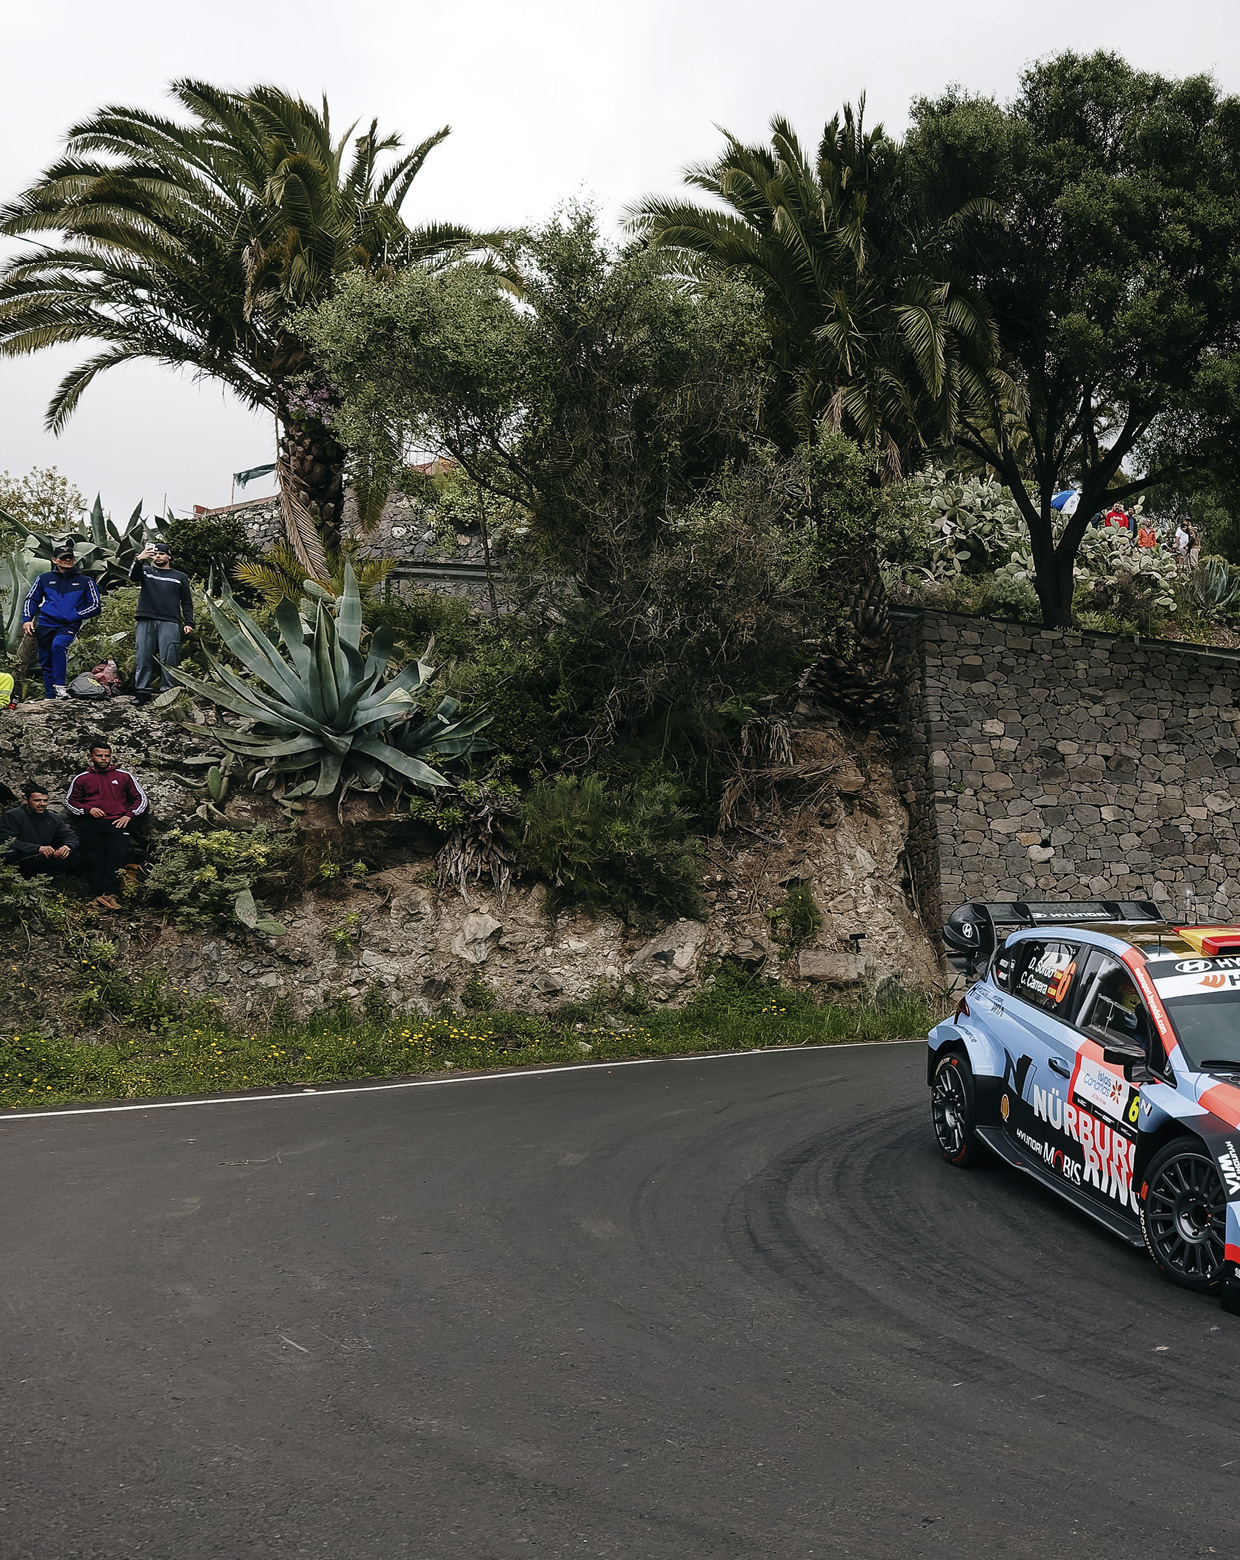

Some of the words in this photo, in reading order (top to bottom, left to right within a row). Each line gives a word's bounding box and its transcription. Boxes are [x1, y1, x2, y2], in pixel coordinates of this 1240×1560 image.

[1020, 971, 1032, 985] C.
[1027, 974, 1048, 995] Carrera
[1028, 957, 1037, 970] D.
[1035, 959, 1054, 979] Sordo
[1055, 961, 1077, 1003] 6
[1134, 967, 1167, 1036] motorsport.hyundai.com
[1097, 1070, 1112, 1087] Islas
[1128, 1096, 1140, 1122] 6
[1016, 1128, 1043, 1156] HYUNDAI
[1043, 1142, 1082, 1186] MOBIS
[1217, 1153, 1240, 1195] WIA
